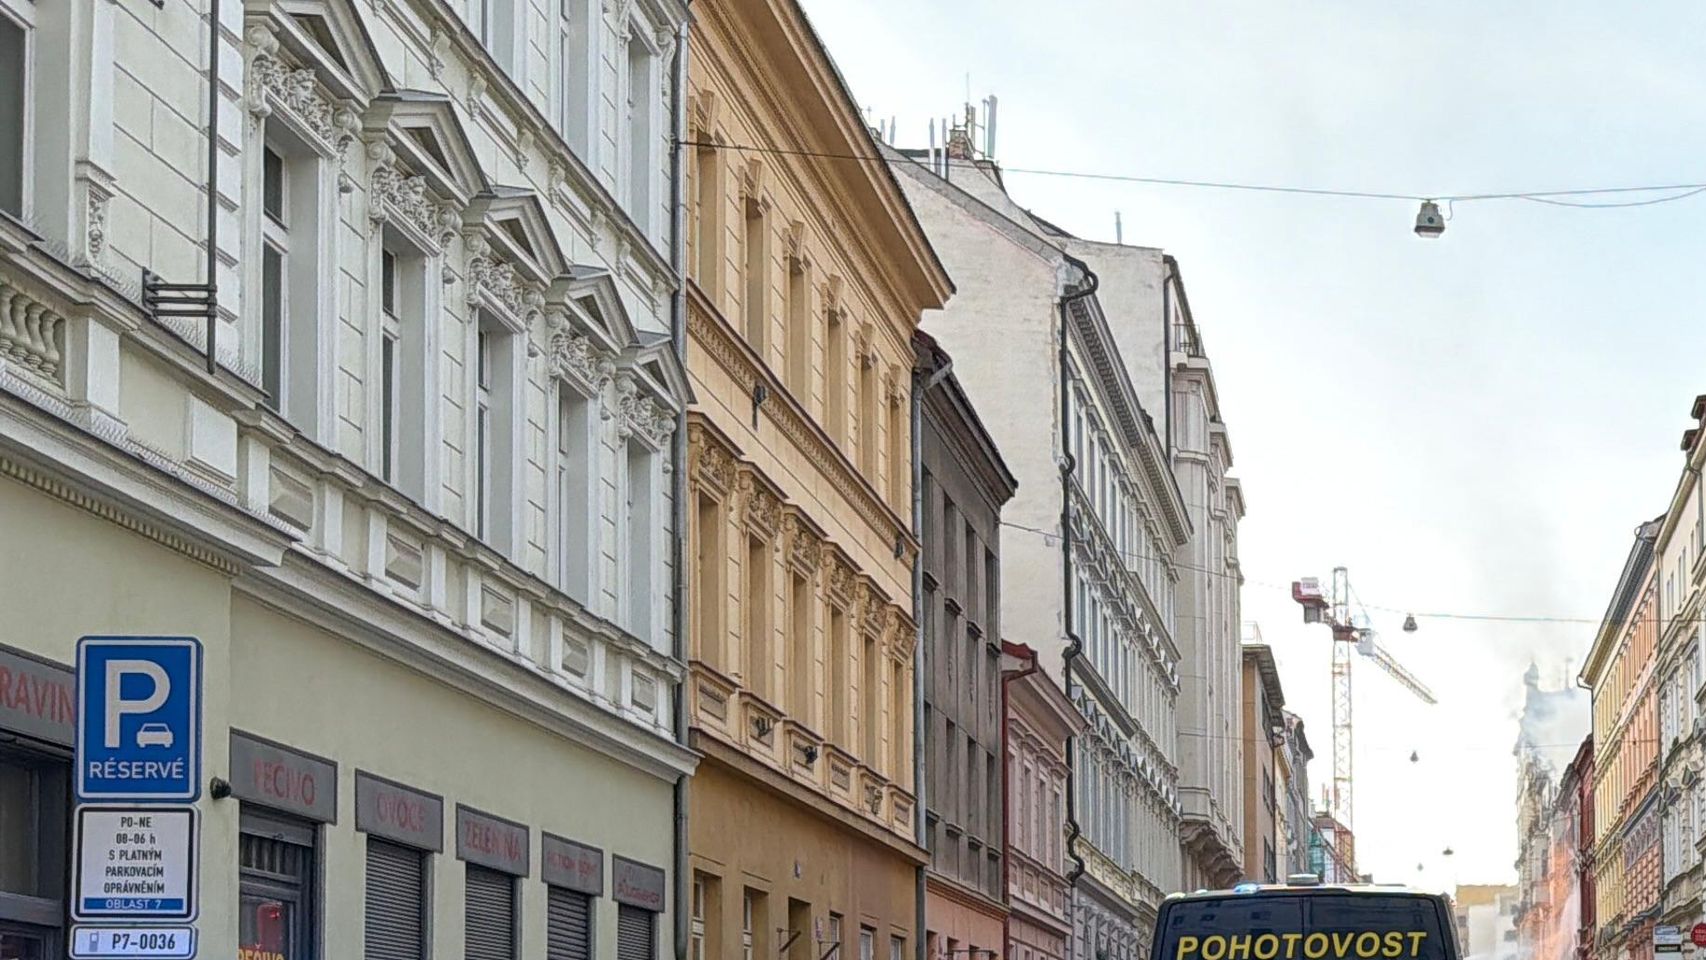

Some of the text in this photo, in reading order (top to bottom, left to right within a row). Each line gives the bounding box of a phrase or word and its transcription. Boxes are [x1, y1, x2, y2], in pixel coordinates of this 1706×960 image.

[105, 659, 171, 748] P
[89, 757, 184, 779] RÉSERVÉ
[376, 792, 425, 832] OVOCE
[120, 816, 152, 828] PO-NE
[116, 833, 156, 844] 08-06 h
[108, 847, 162, 861] S PLATNÝM
[105, 863, 164, 877] PARKOVACÍM
[104, 880, 165, 894] OPRÁVNĚNÍM
[105, 899, 162, 909] OBLAST 7
[112, 933, 176, 950] P7-0036
